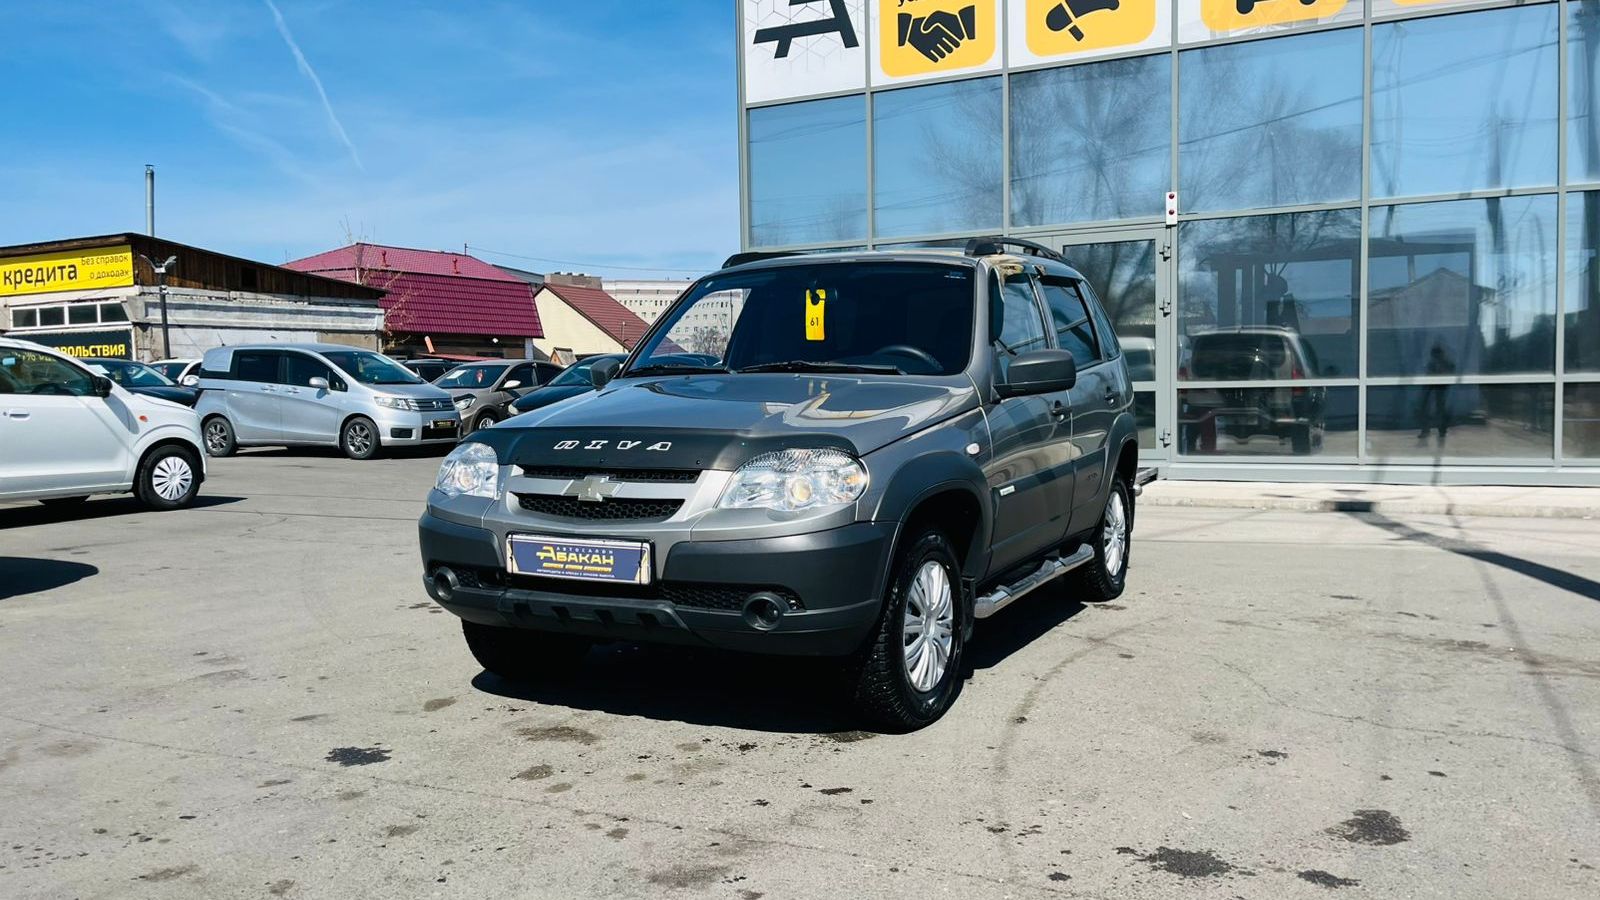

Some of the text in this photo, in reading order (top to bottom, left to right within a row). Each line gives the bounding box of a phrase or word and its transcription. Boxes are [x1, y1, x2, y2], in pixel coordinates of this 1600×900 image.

[96, 254, 129, 266] справок
[3, 264, 78, 290] кредита
[95, 269, 129, 280] доходах
[810, 317, 819, 327] 61
[536, 545, 614, 566] АБАКАН
[556, 546, 614, 554] АВТОСАЛОН
